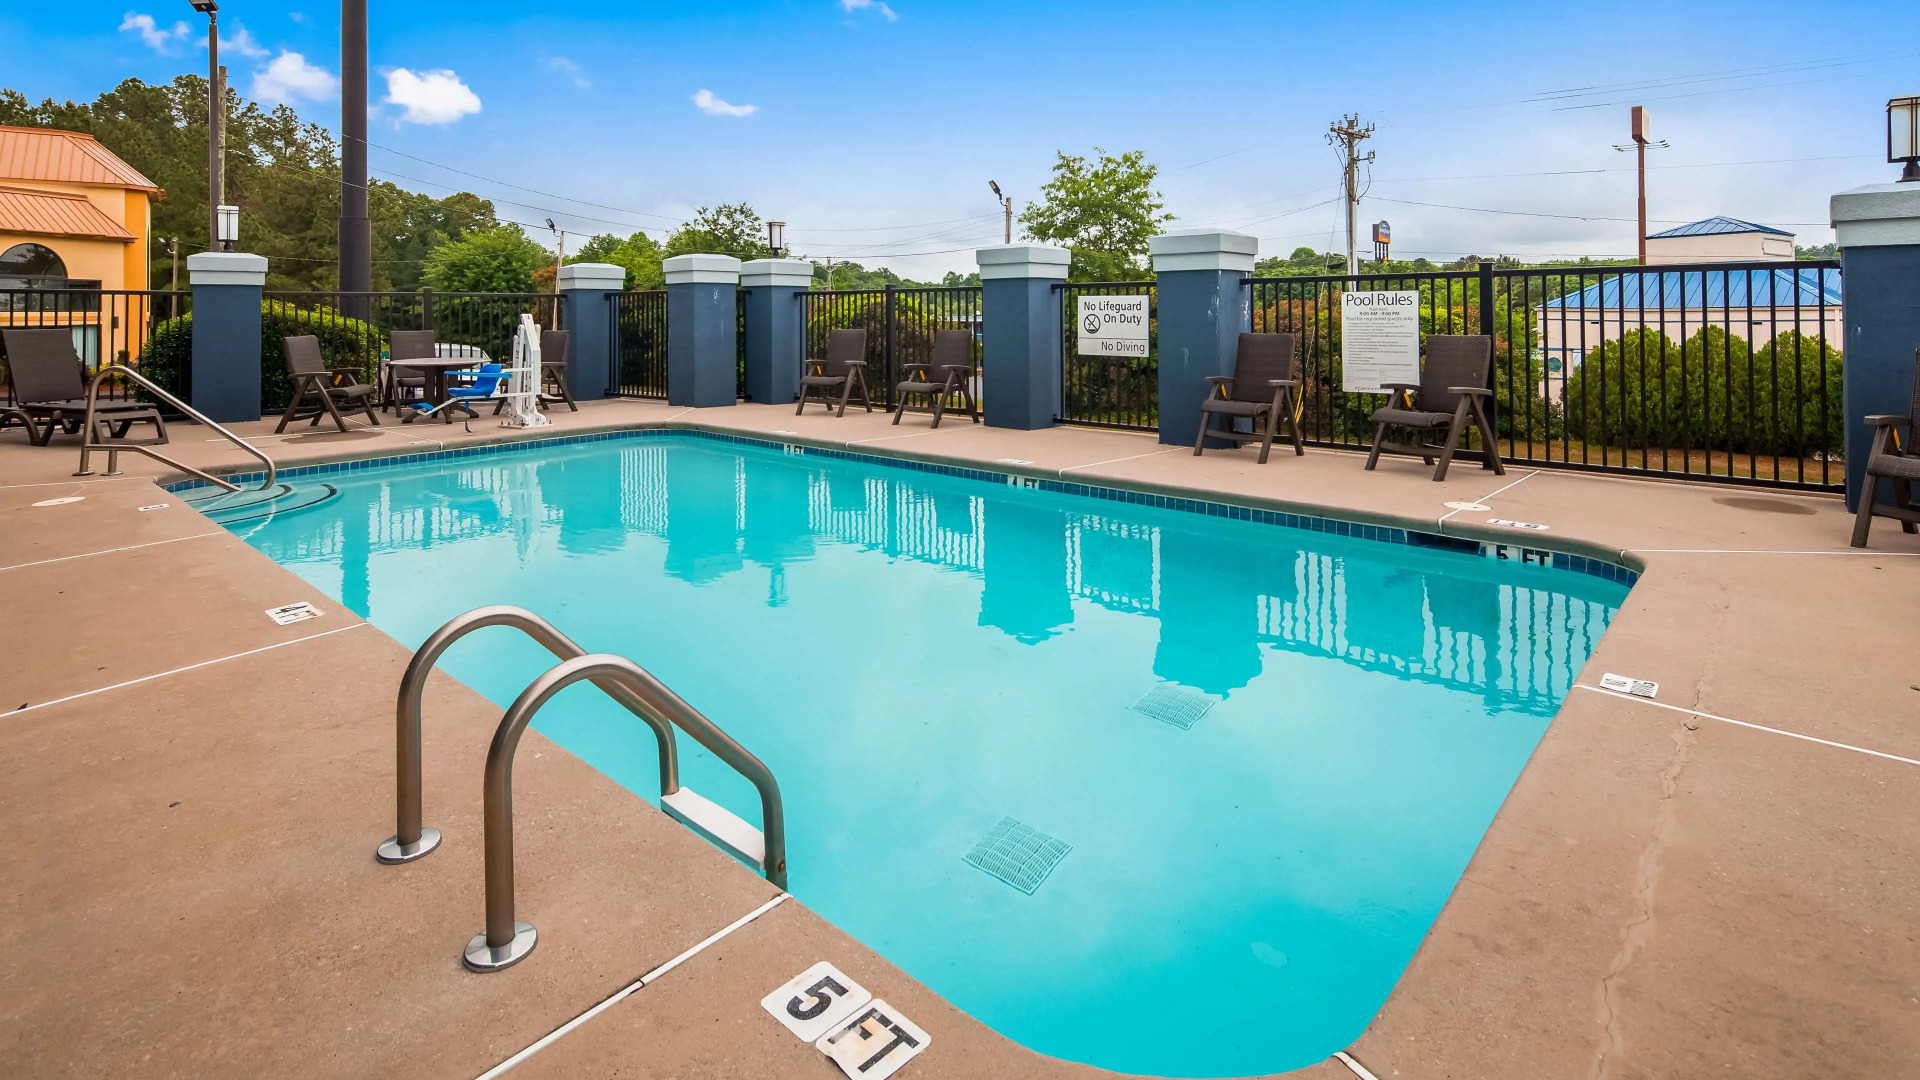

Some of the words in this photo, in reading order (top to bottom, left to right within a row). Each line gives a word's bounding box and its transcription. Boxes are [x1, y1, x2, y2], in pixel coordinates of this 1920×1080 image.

[1084, 301, 1096, 311] No
[1099, 300, 1142, 313] Lifeguard
[1346, 293, 1374, 306] Pool
[1377, 293, 1413, 306] Rules
[1103, 313, 1117, 323] On
[1119, 313, 1142, 326] Duty
[1101, 341, 1114, 351] No
[1116, 341, 1145, 355] Diving
[1011, 475, 1018, 486] 4
[1023, 477, 1038, 489] FT
[1495, 544, 1509, 560] 5
[1521, 547, 1550, 566] FT
[786, 975, 849, 1021] 5
[826, 1007, 920, 1074] FT
